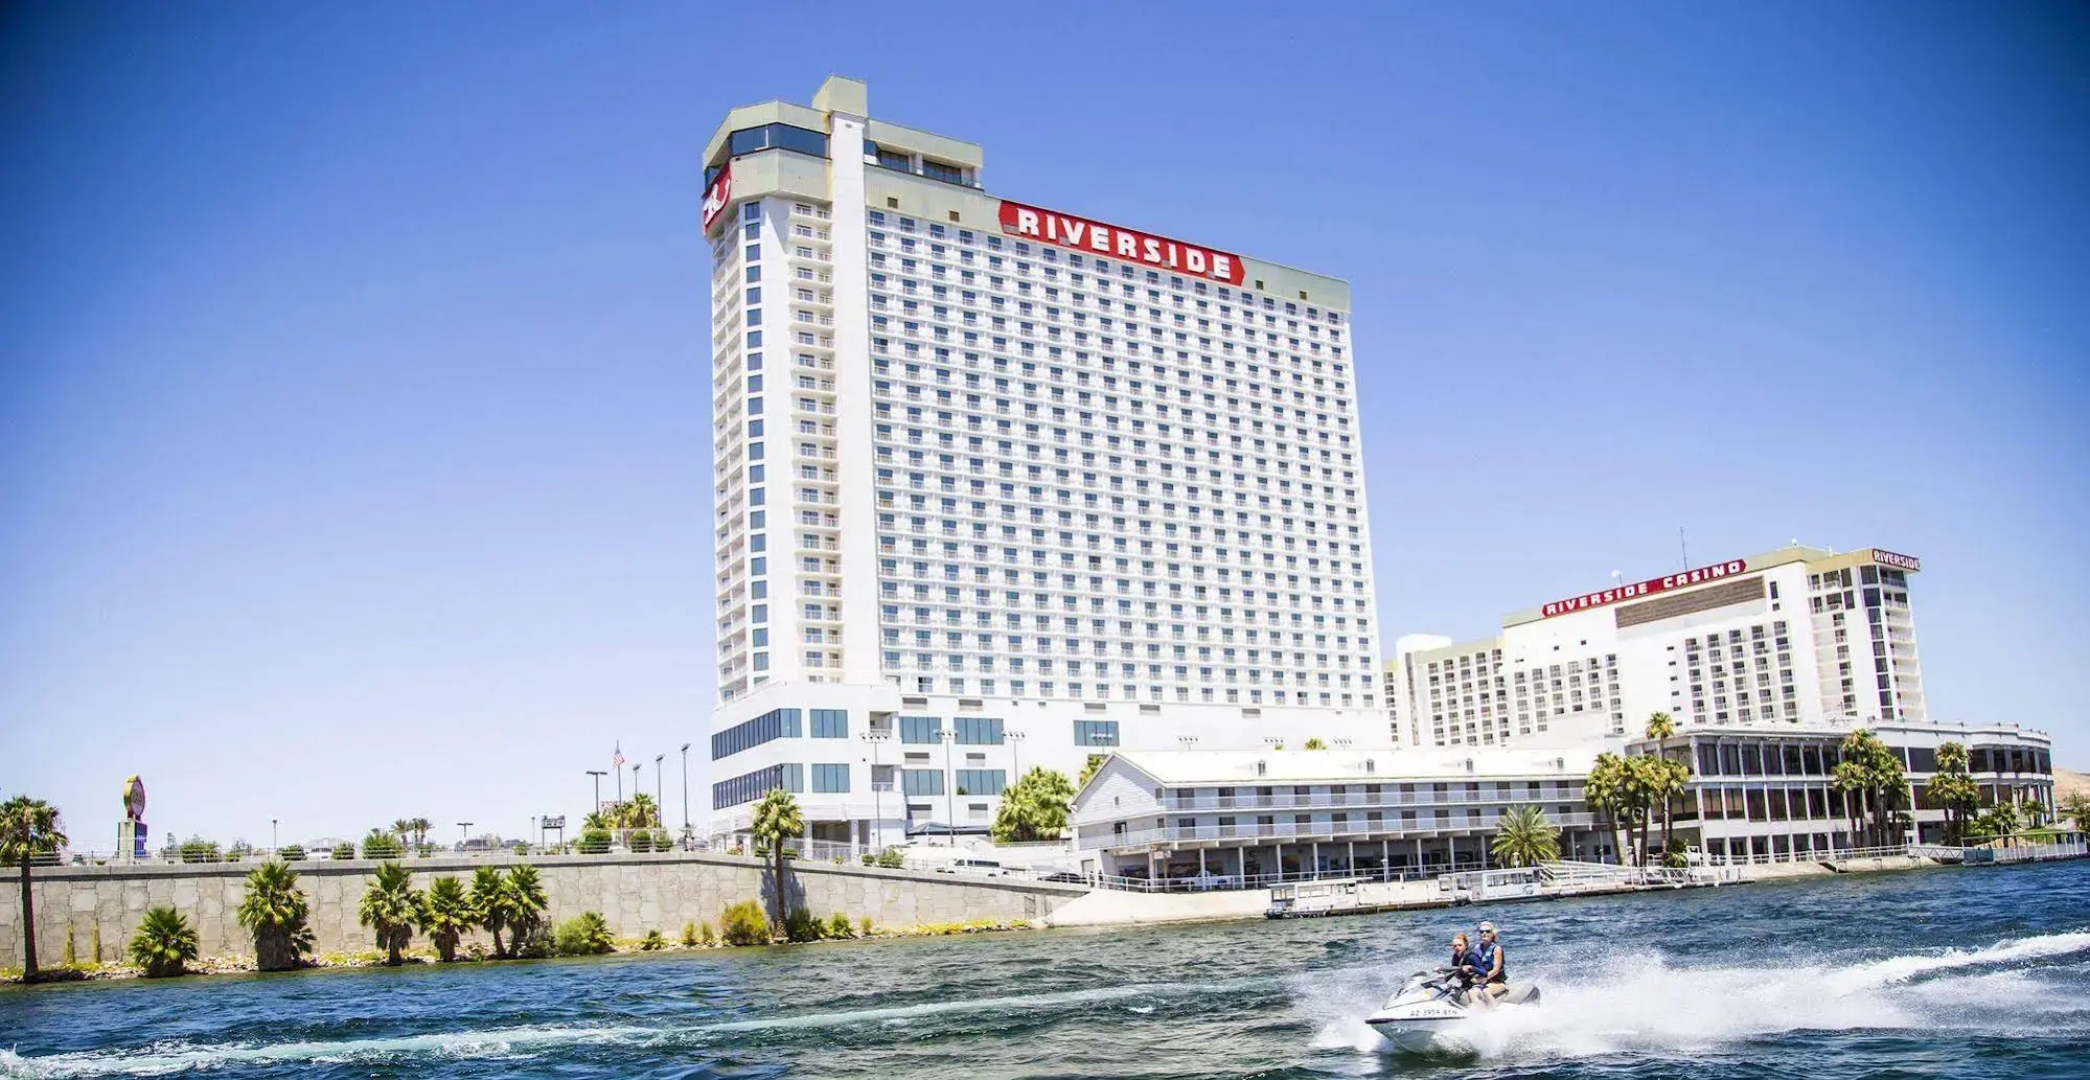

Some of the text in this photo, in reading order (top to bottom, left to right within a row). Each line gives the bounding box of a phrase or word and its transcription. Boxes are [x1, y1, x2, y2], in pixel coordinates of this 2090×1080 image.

[1018, 208, 1231, 279] RIVERSIDE
[1874, 551, 1920, 570] RIVERSIDE
[1547, 561, 1740, 616] RIVERSIDE CASINO
